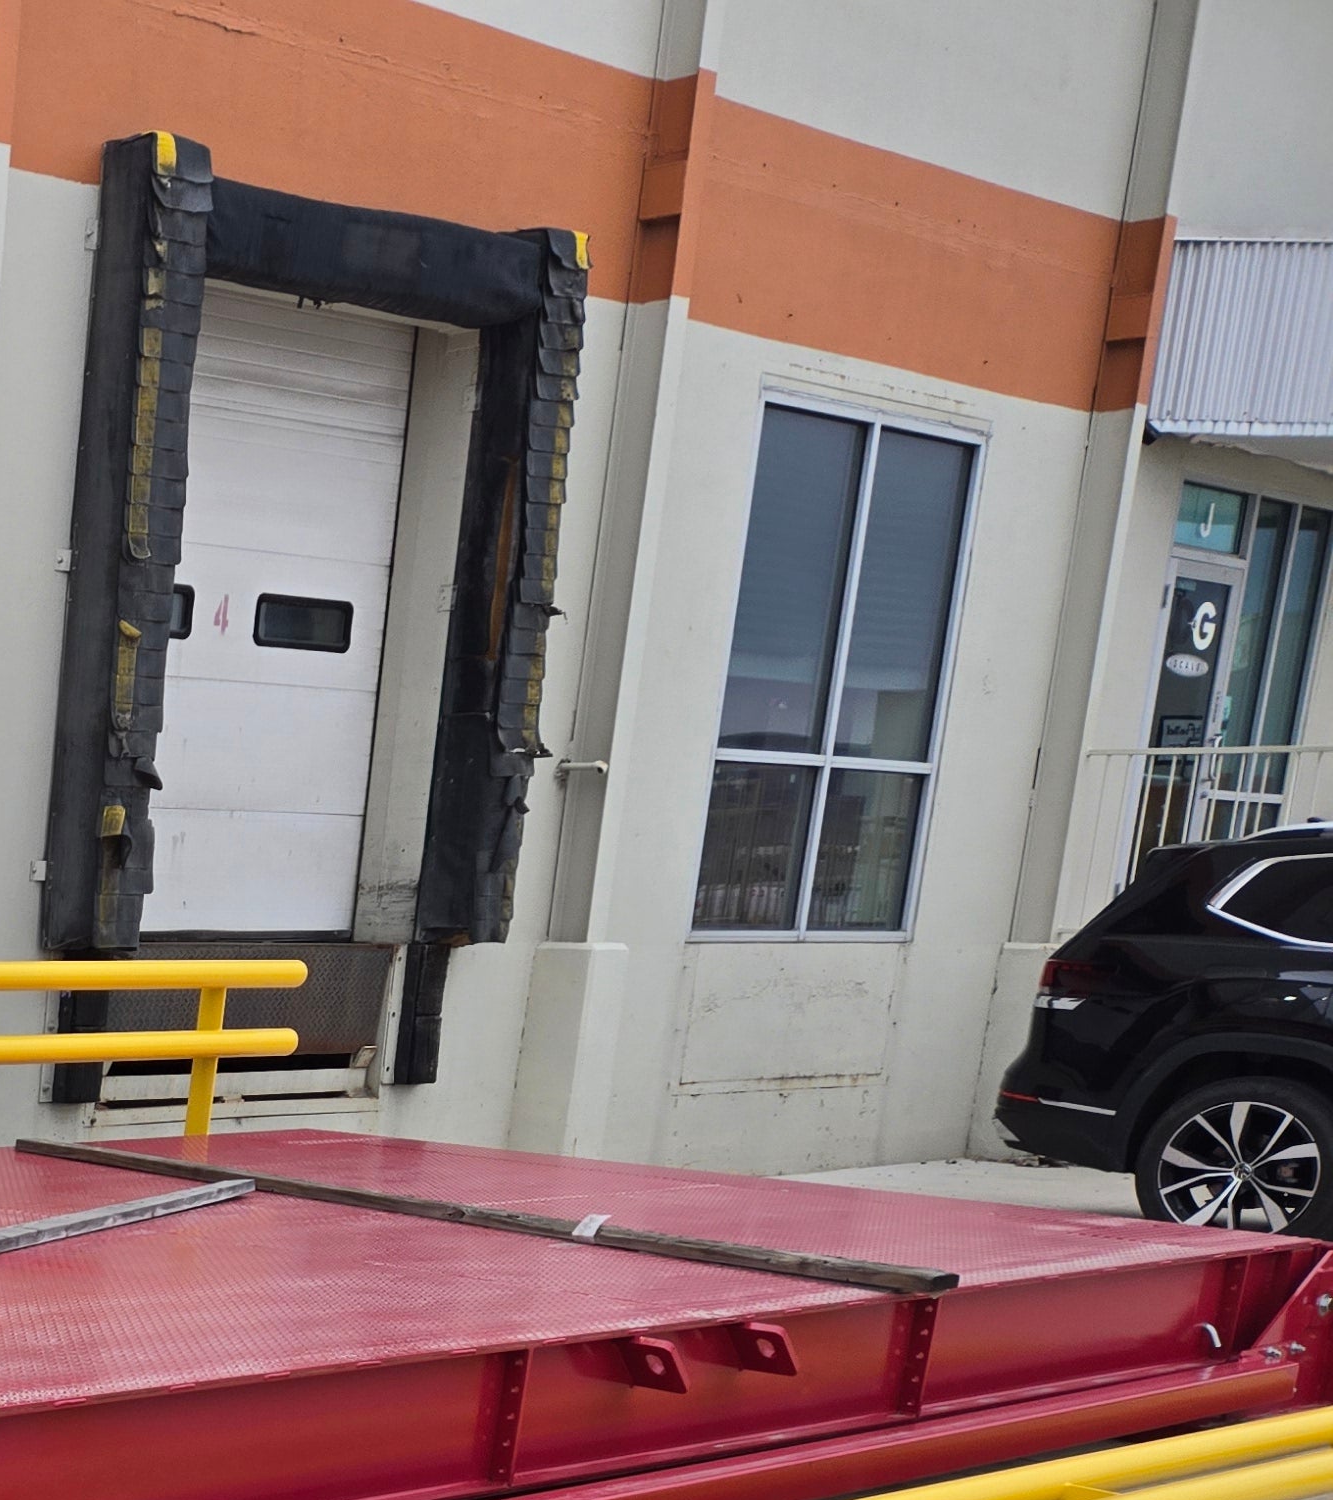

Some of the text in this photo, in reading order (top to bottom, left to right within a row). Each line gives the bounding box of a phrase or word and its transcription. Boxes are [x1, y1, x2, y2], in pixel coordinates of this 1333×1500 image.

[1200, 503, 1215, 538] J
[213, 594, 230, 635] 4
[1192, 601, 1217, 651] G
